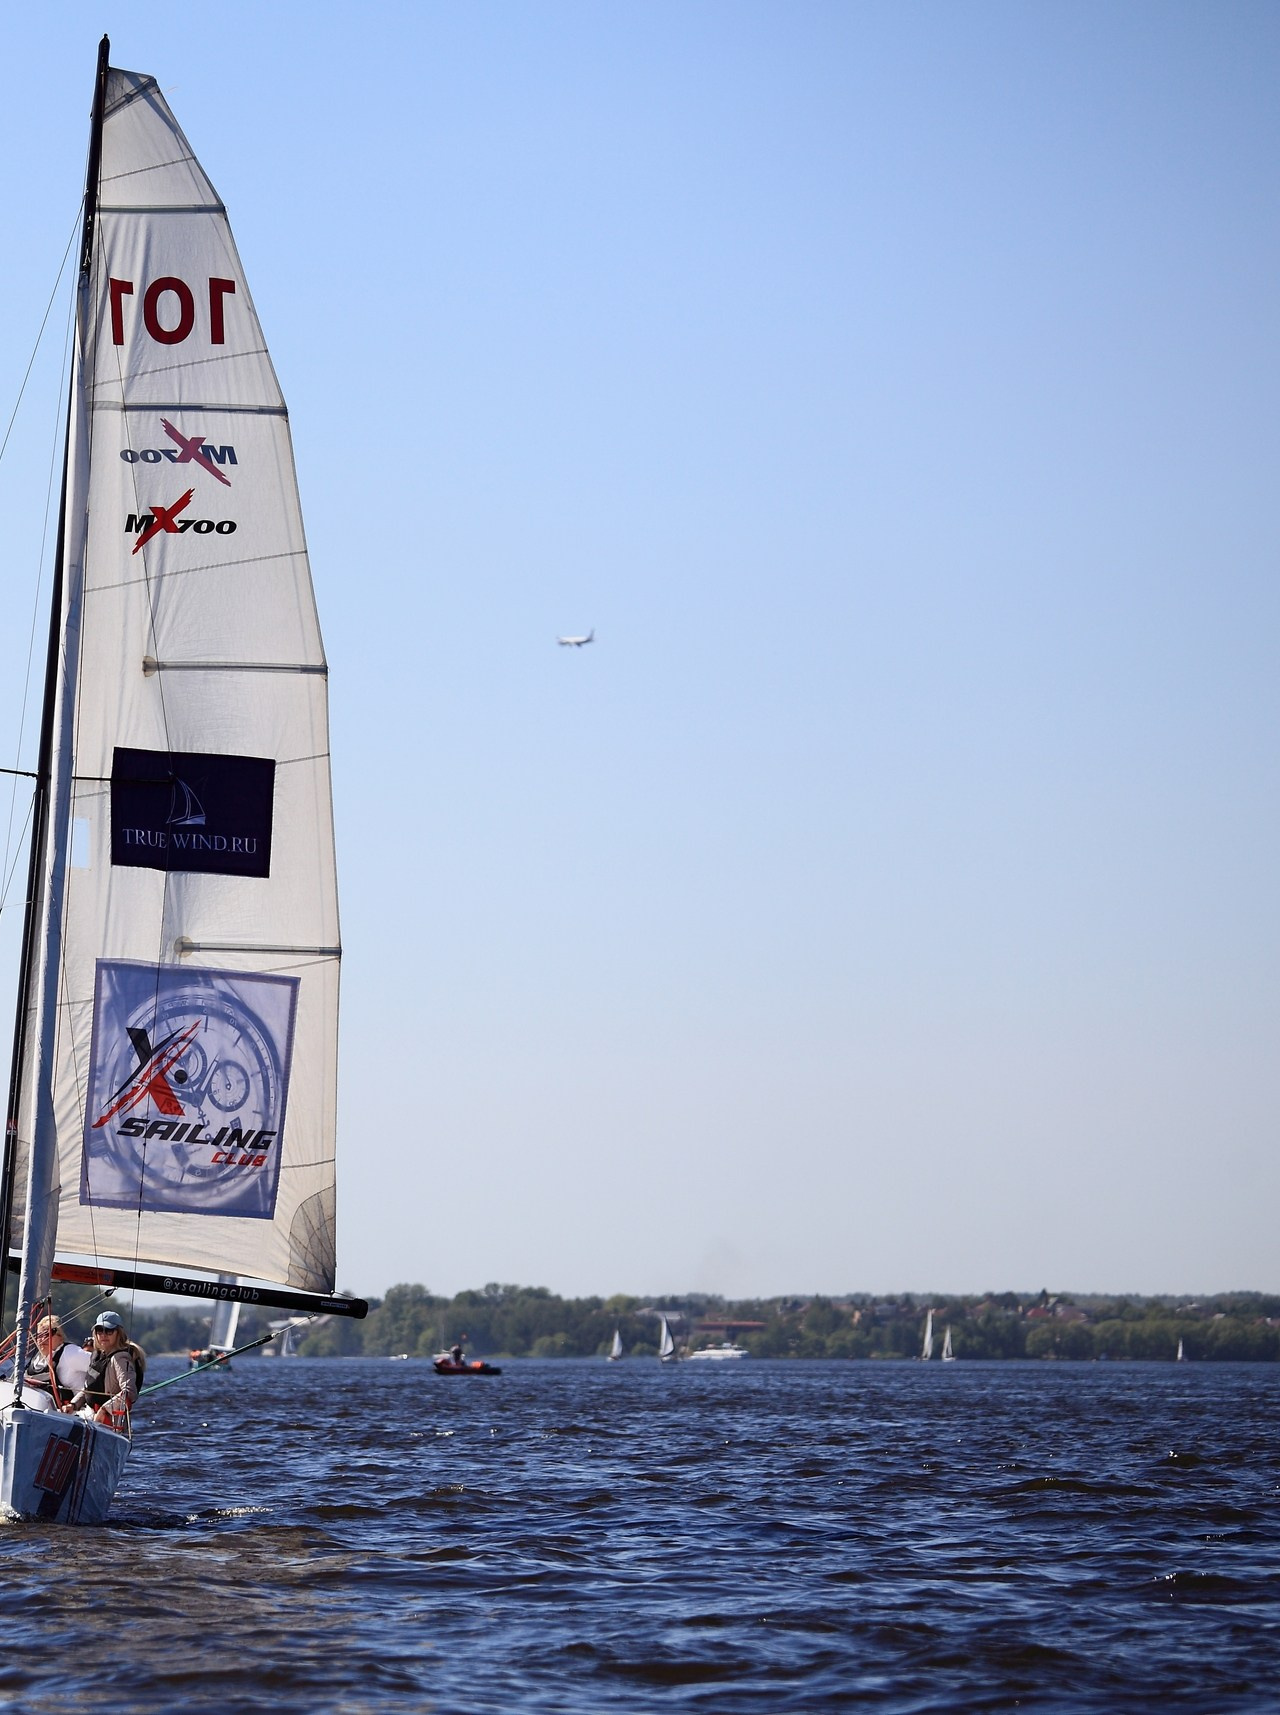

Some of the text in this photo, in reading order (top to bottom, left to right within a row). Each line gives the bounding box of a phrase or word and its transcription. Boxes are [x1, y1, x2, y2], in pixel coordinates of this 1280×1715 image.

[124, 488, 237, 555] MX700
[122, 828, 257, 854] TRUE WIND.RU
[117, 1118, 277, 1150] SAILING
[211, 1151, 267, 1167] CLUB
[163, 1277, 260, 1300] @xsailingclub
